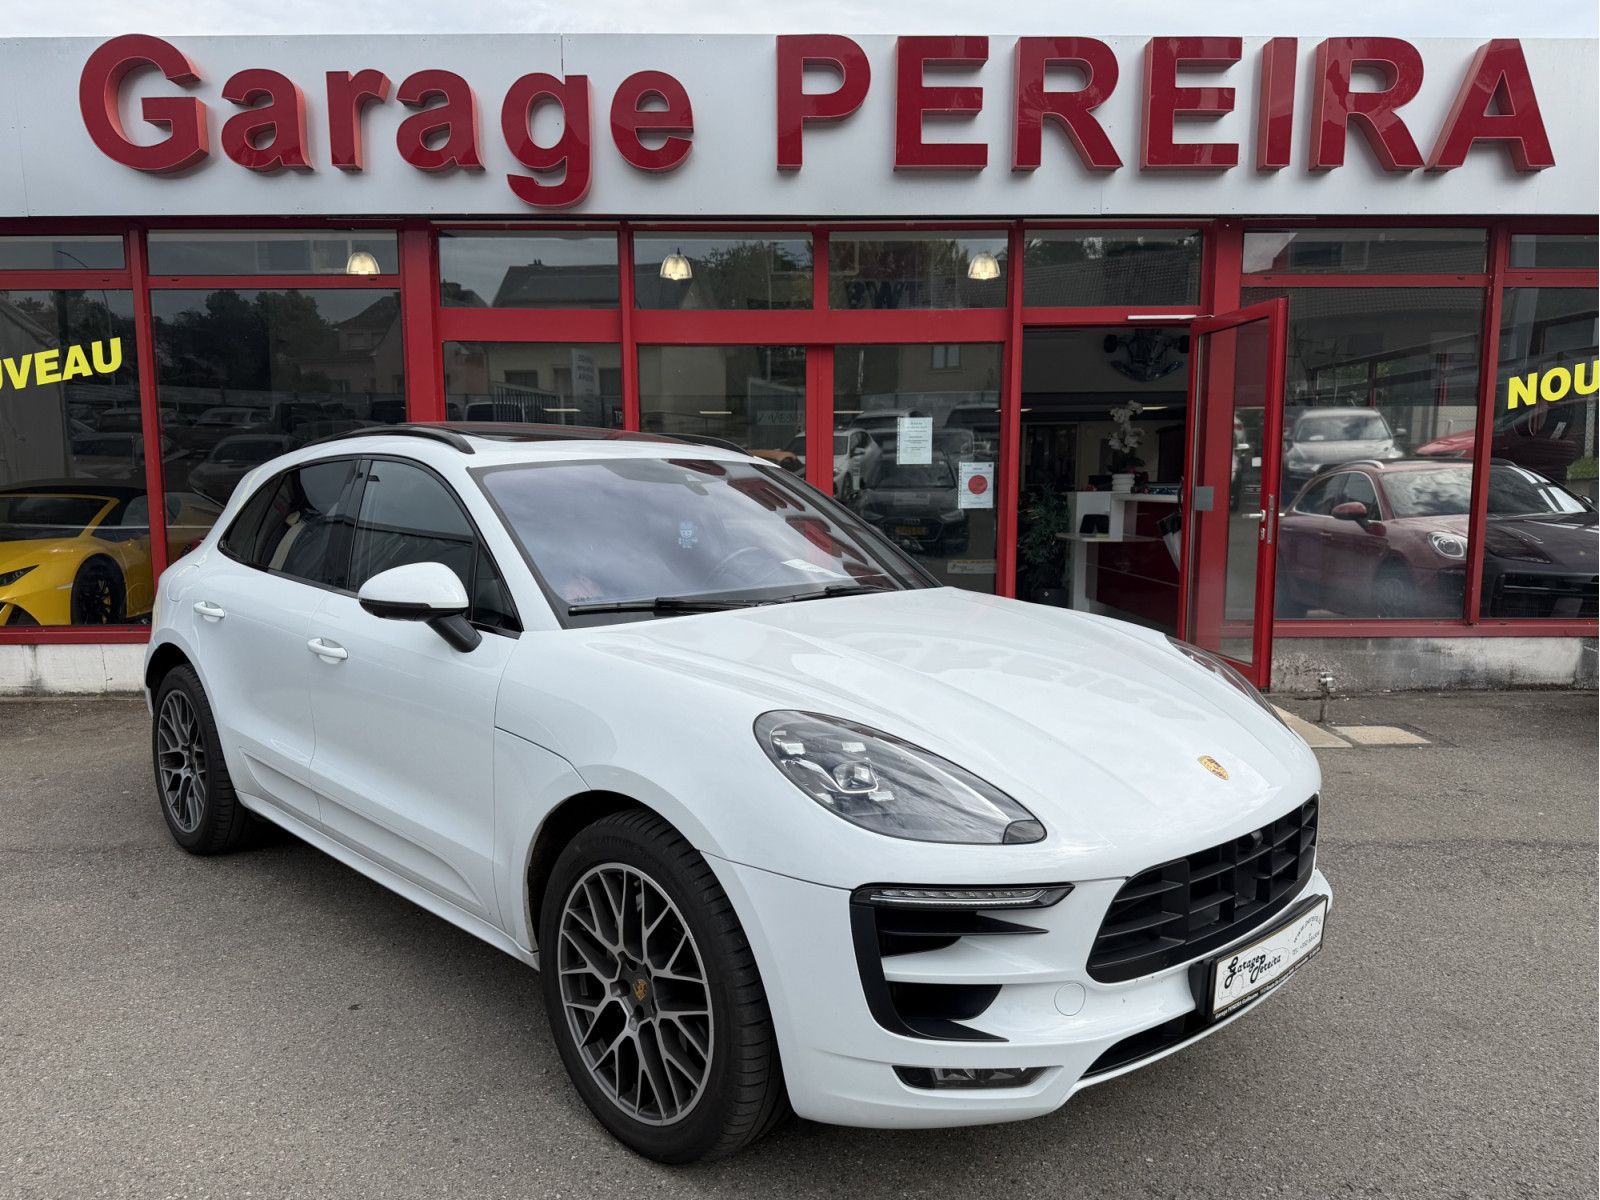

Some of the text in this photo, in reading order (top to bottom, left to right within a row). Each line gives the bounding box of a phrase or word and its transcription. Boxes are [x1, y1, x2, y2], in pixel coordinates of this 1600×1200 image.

[79, 34, 1555, 208] Garage PEREIRA
[0, 337, 122, 390] VEAU
[1507, 360, 1600, 410] NOU
